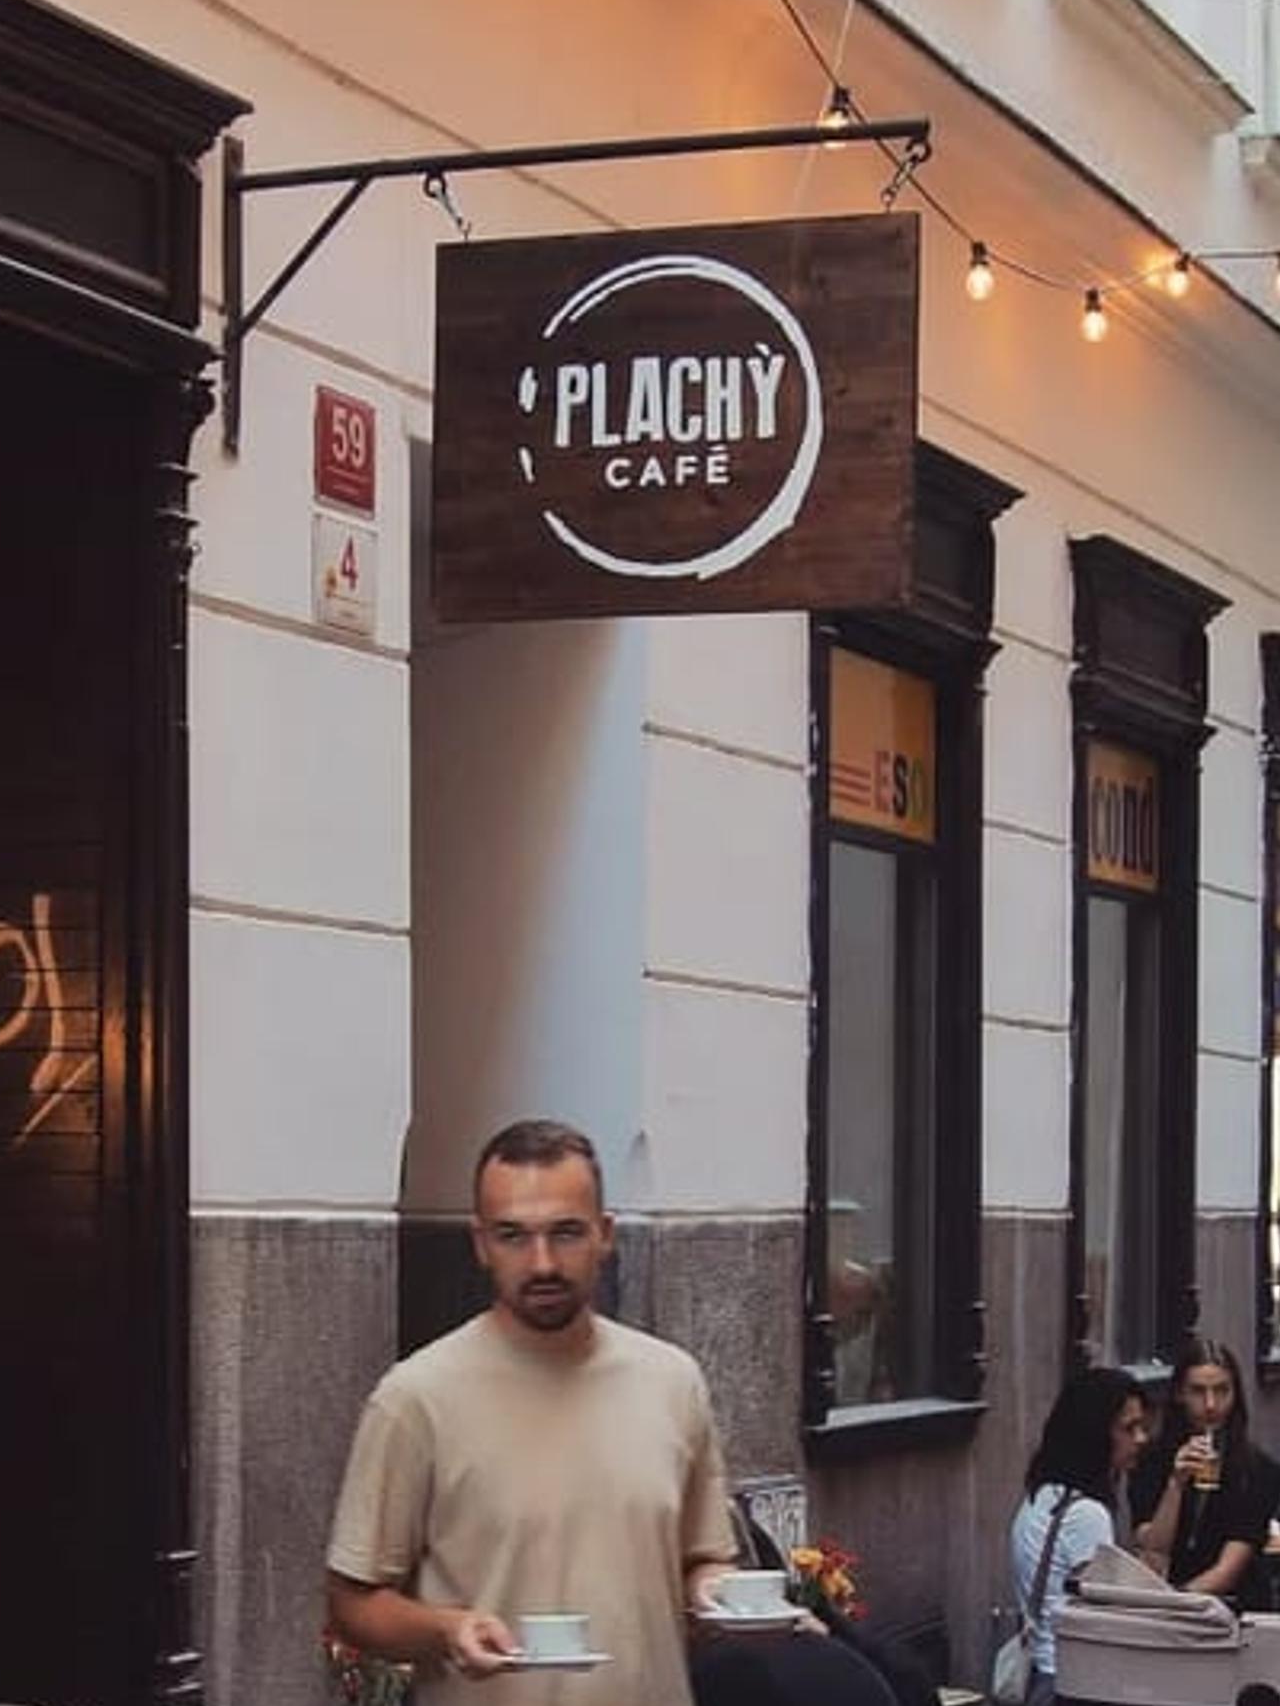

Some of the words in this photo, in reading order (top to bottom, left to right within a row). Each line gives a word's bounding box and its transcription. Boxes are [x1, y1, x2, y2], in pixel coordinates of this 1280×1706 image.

[332, 406, 367, 469] 59
[605, 444, 730, 488] CAFÉ
[340, 534, 358, 591] 4
